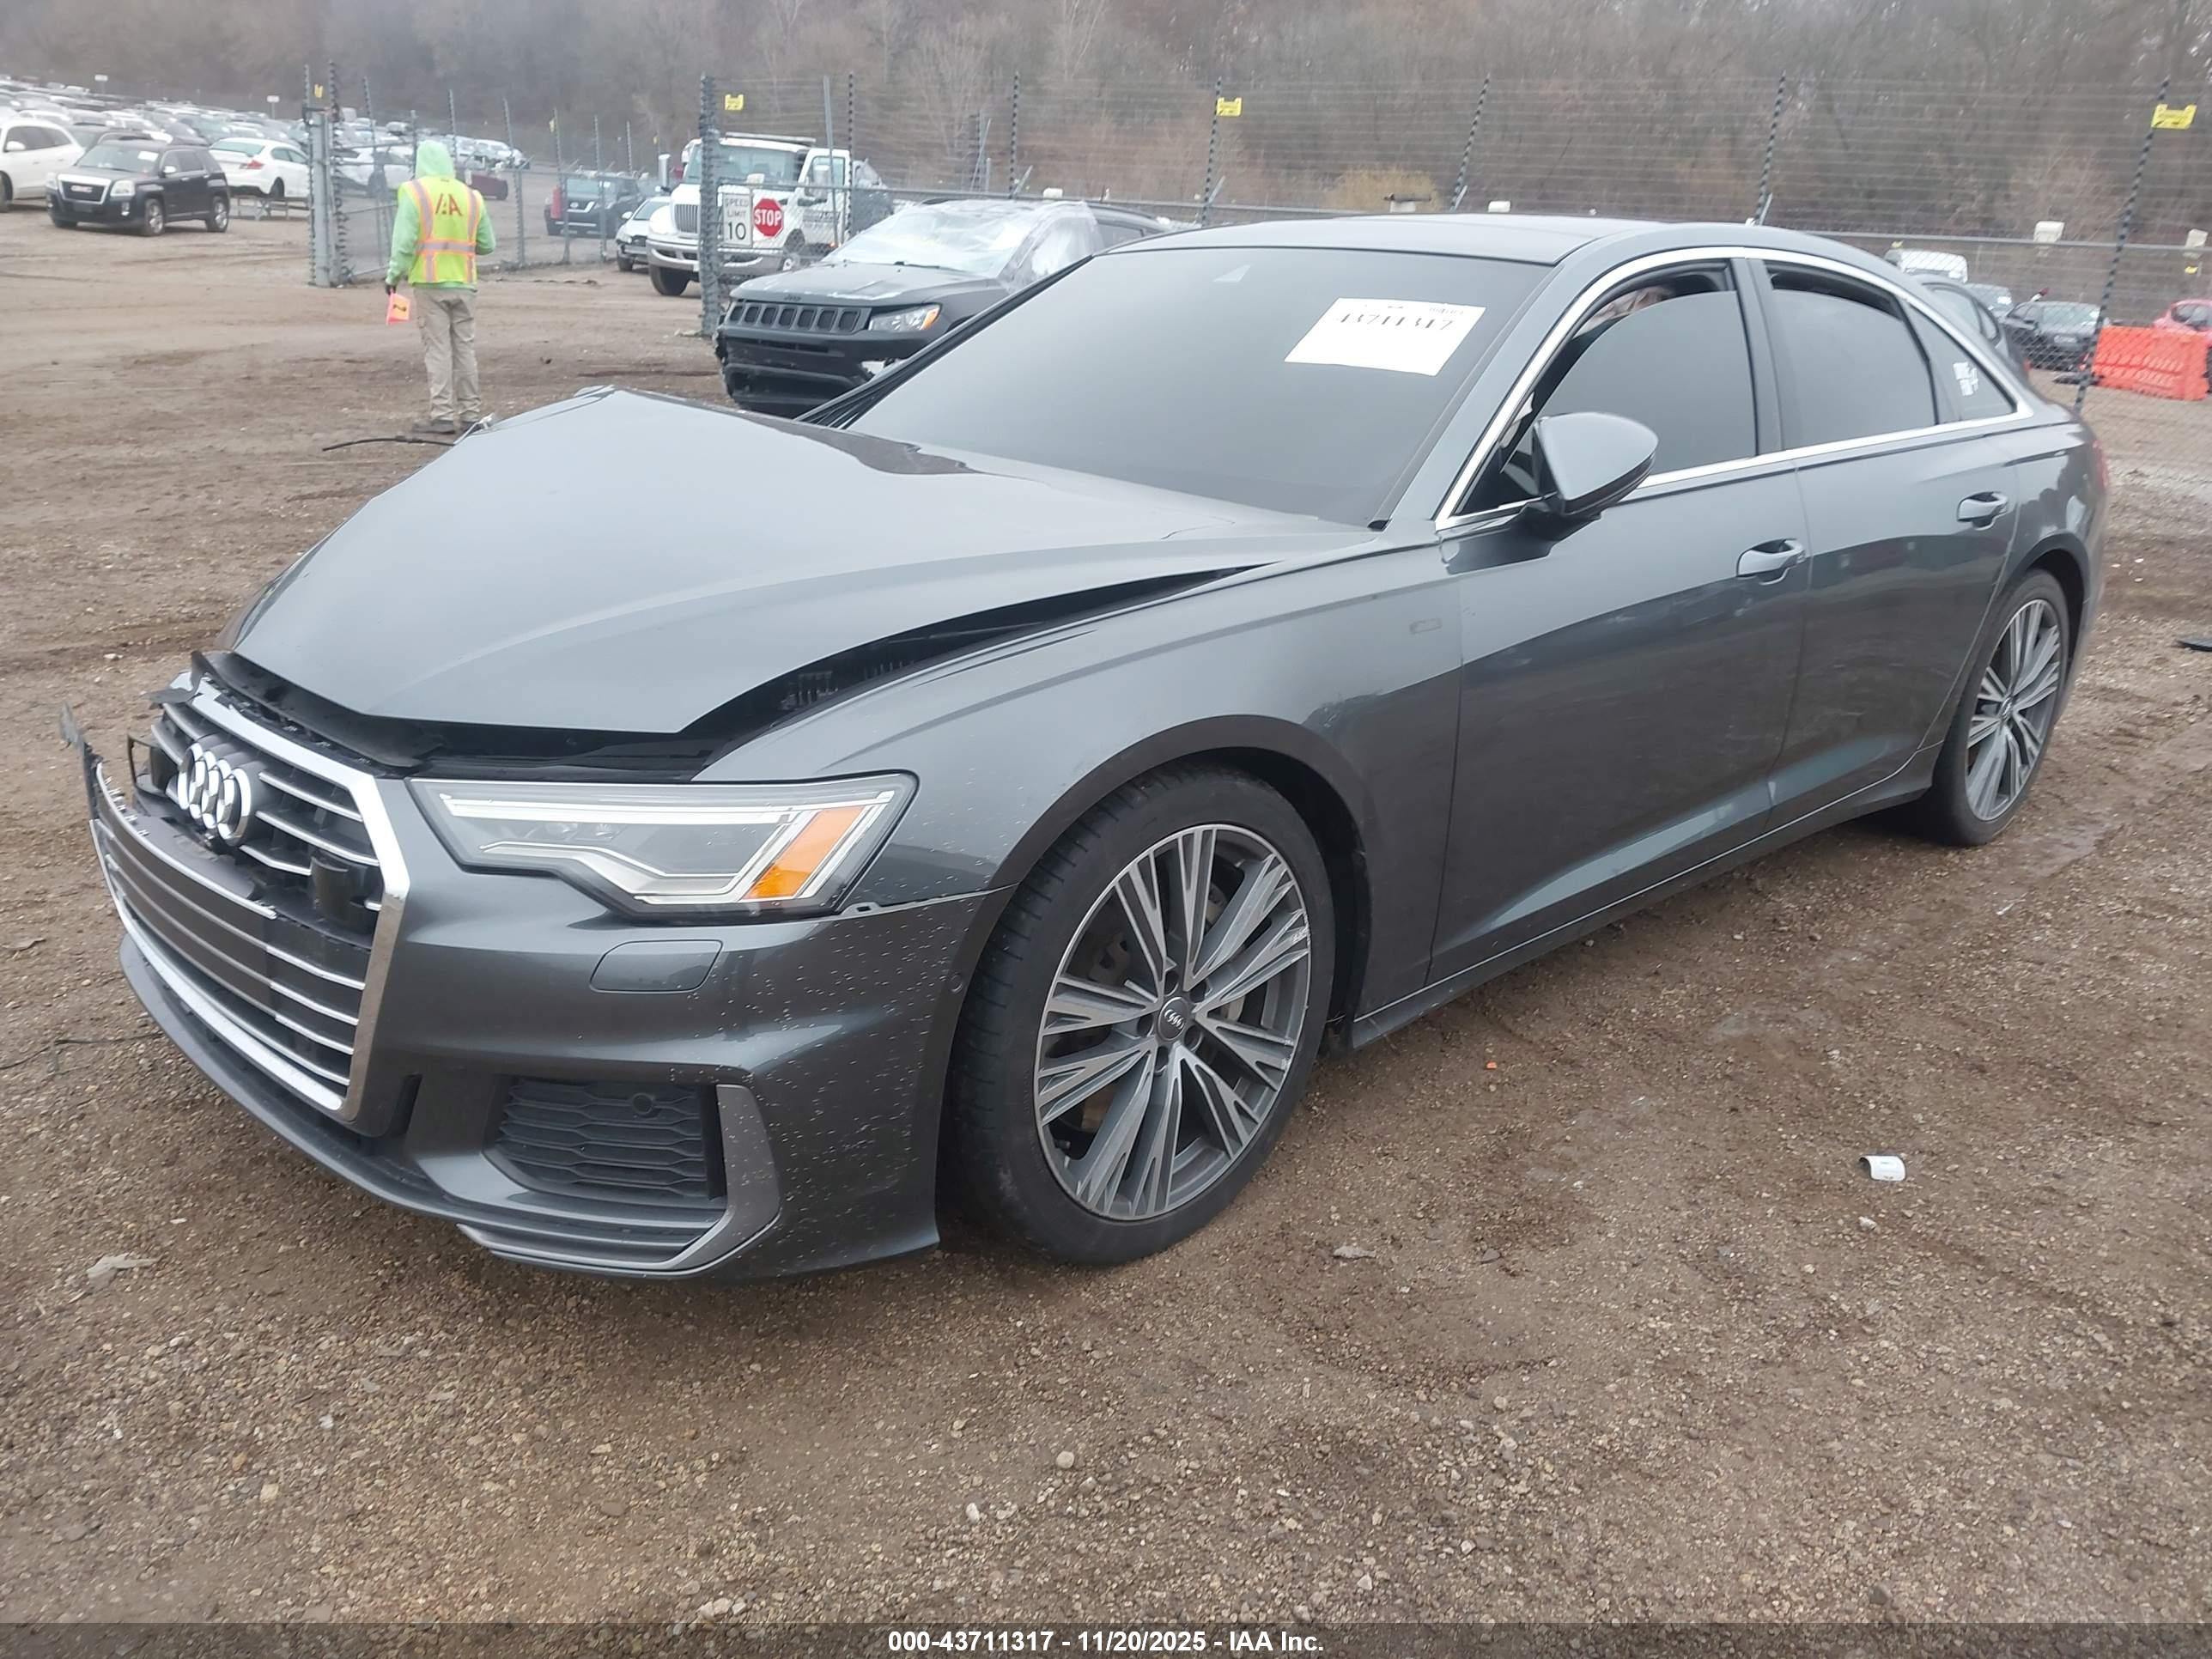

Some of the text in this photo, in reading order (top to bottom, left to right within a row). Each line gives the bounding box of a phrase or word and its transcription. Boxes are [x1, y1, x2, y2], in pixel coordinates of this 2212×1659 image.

[724, 198, 750, 207] SPEED
[754, 209, 782, 227] STOP
[727, 222, 747, 240] 10
